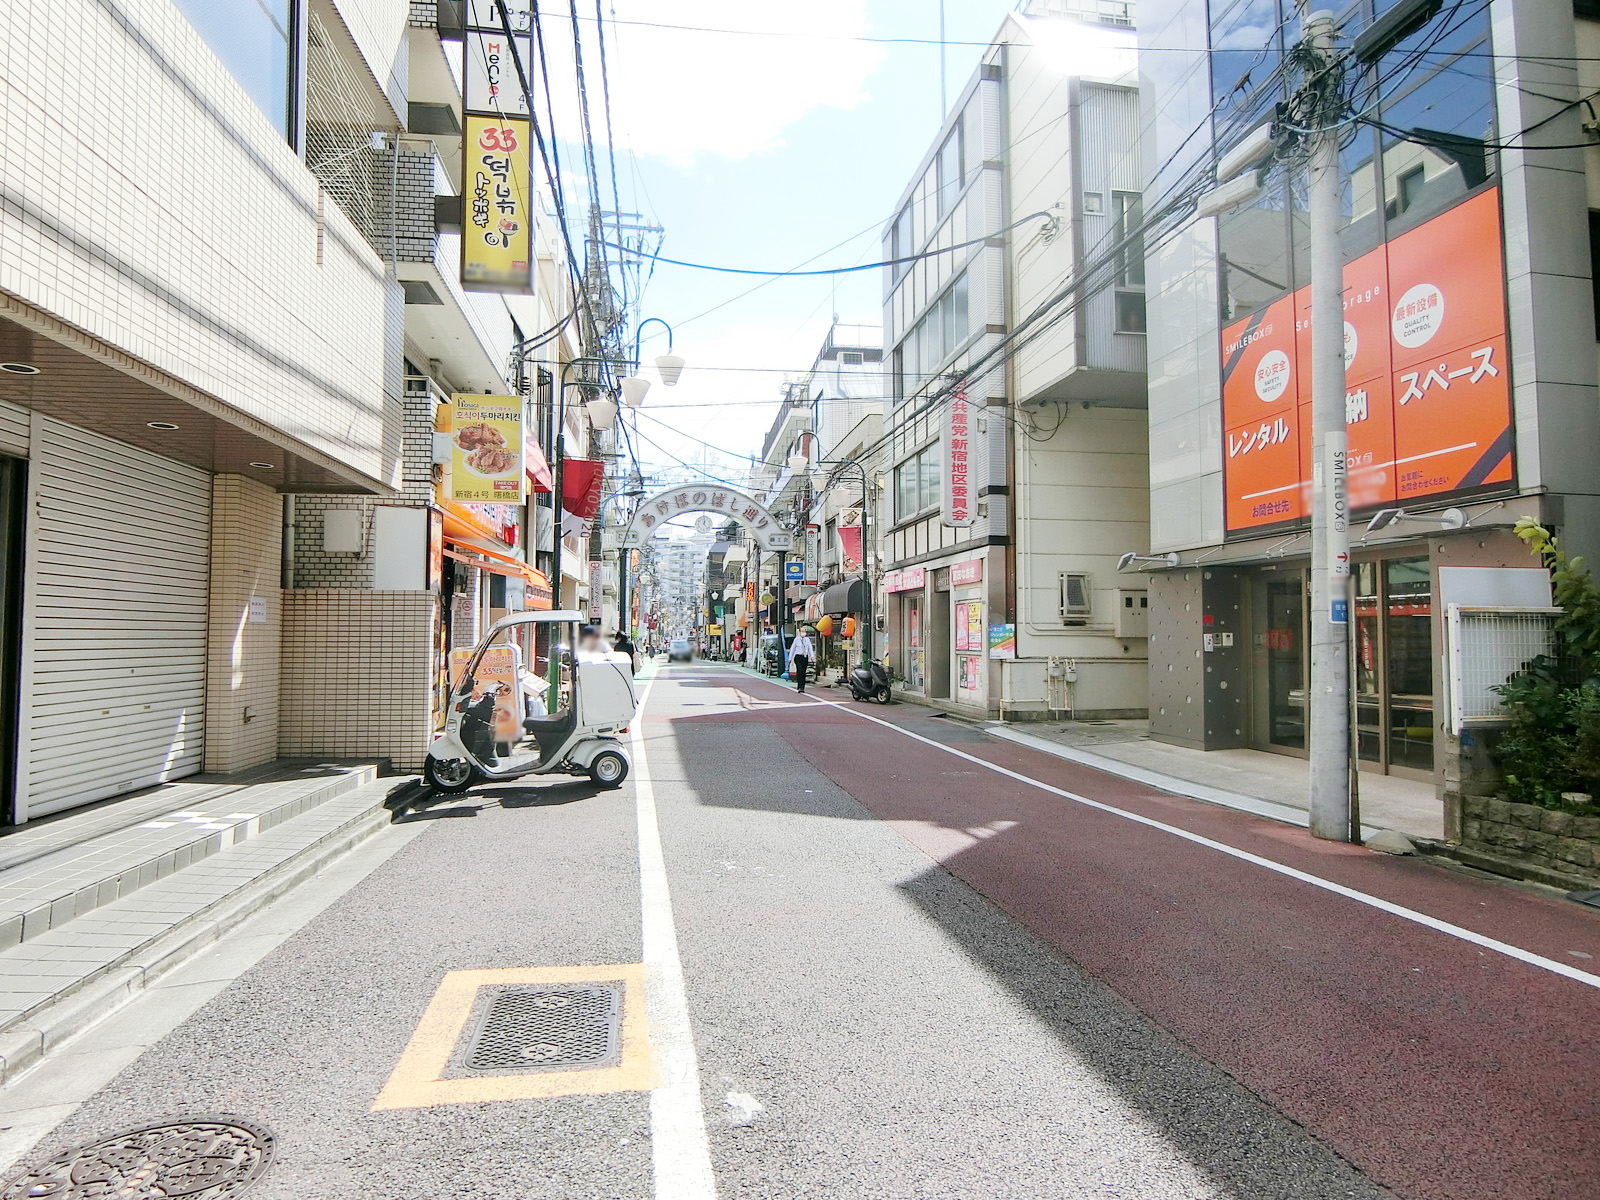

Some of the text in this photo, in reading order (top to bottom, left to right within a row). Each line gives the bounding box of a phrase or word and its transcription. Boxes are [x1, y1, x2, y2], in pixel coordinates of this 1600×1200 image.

[479, 127, 517, 152] 33
[1395, 292, 1438, 322] 最新設備
[1403, 323, 1431, 338] CONTROL
[1404, 314, 1429, 329] QUALITY
[1225, 328, 1265, 355] SMILEBOX
[1257, 360, 1286, 381] 安心安全
[1399, 346, 1499, 406] スペース
[1229, 417, 1290, 458] レンタル
[951, 438, 968, 521] 新宿地区委員会
[641, 492, 768, 528] あけぼのばし通り
